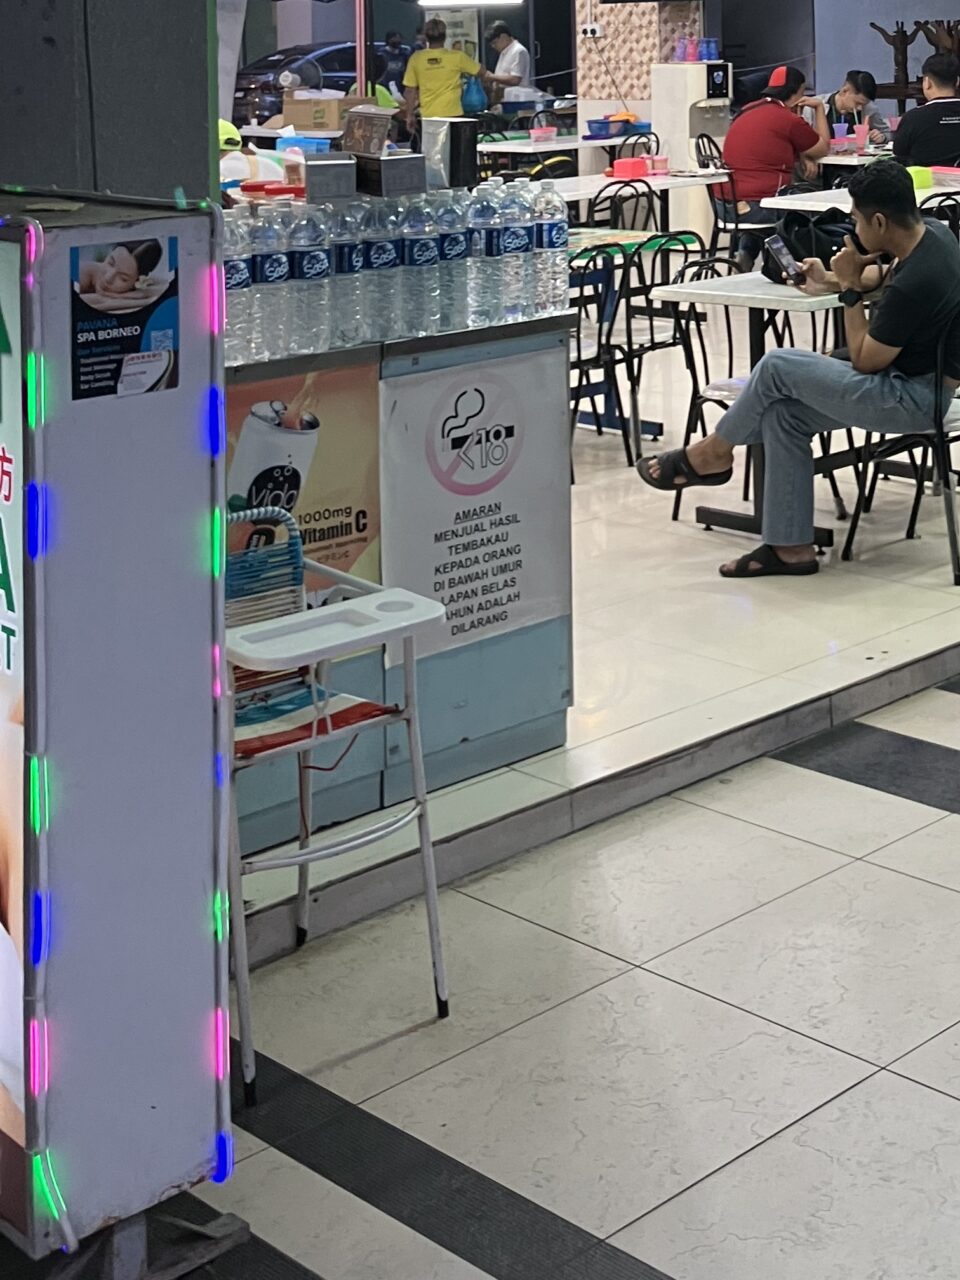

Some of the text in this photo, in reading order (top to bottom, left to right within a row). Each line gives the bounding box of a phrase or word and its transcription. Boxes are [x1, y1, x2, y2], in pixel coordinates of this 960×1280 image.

[77, 325, 141, 343] SPA BORNEO
[299, 506, 353, 526] 1000mg
[454, 502, 502, 523] AMARAN
[300, 509, 368, 545] Vitamin C
[434, 513, 521, 543] MENJUAL HASIL
[448, 532, 509, 556] TEMBAKAU
[434, 544, 522, 576] KEPADA ORANG
[434, 559, 523, 592] DI BAWAH UMUR
[481, 577, 517, 596] BELAS
[476, 591, 521, 613] ADALAH
[451, 610, 509, 636] DILARANG
